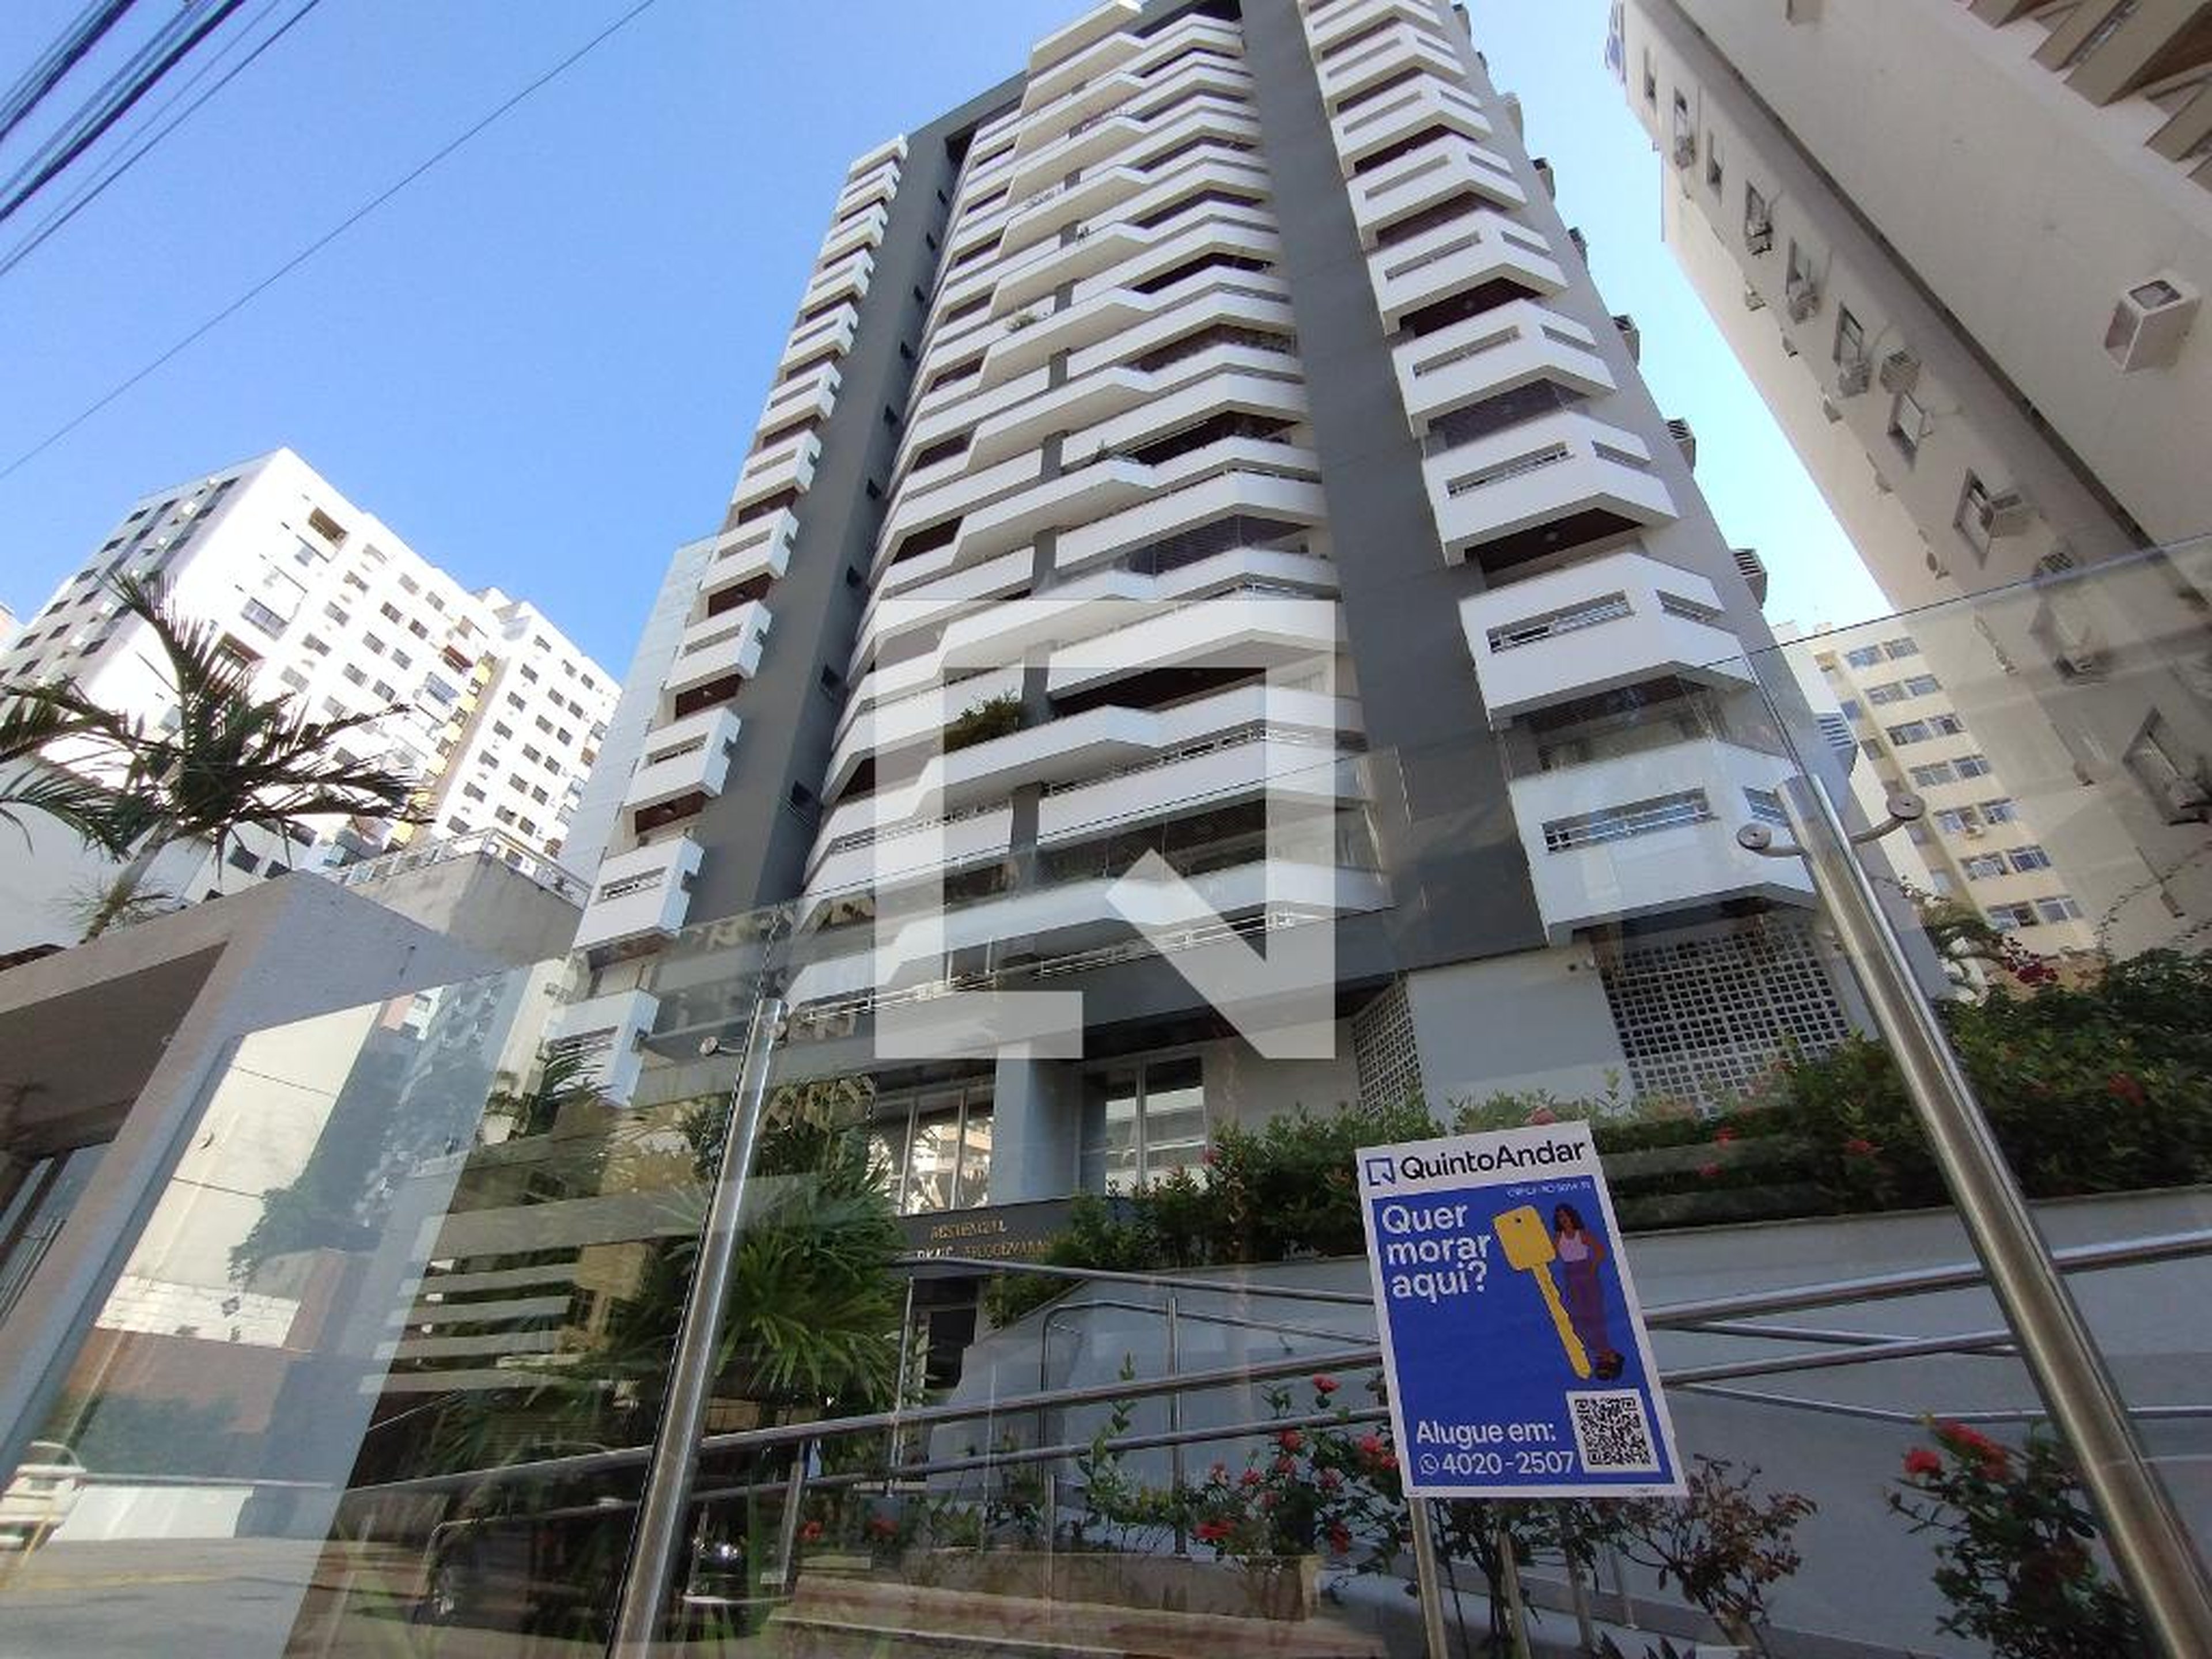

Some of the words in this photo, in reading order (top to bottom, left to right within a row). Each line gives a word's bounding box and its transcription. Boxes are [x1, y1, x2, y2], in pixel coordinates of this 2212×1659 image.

[1400, 1140, 1584, 1180] QuintoAndar
[1382, 1205, 1467, 1233] Quer
[1387, 1234, 1491, 1264] morar
[1392, 1260, 1487, 1304] aqui?
[1416, 1421, 1503, 1450] Alugue
[1508, 1423, 1556, 1441] em:
